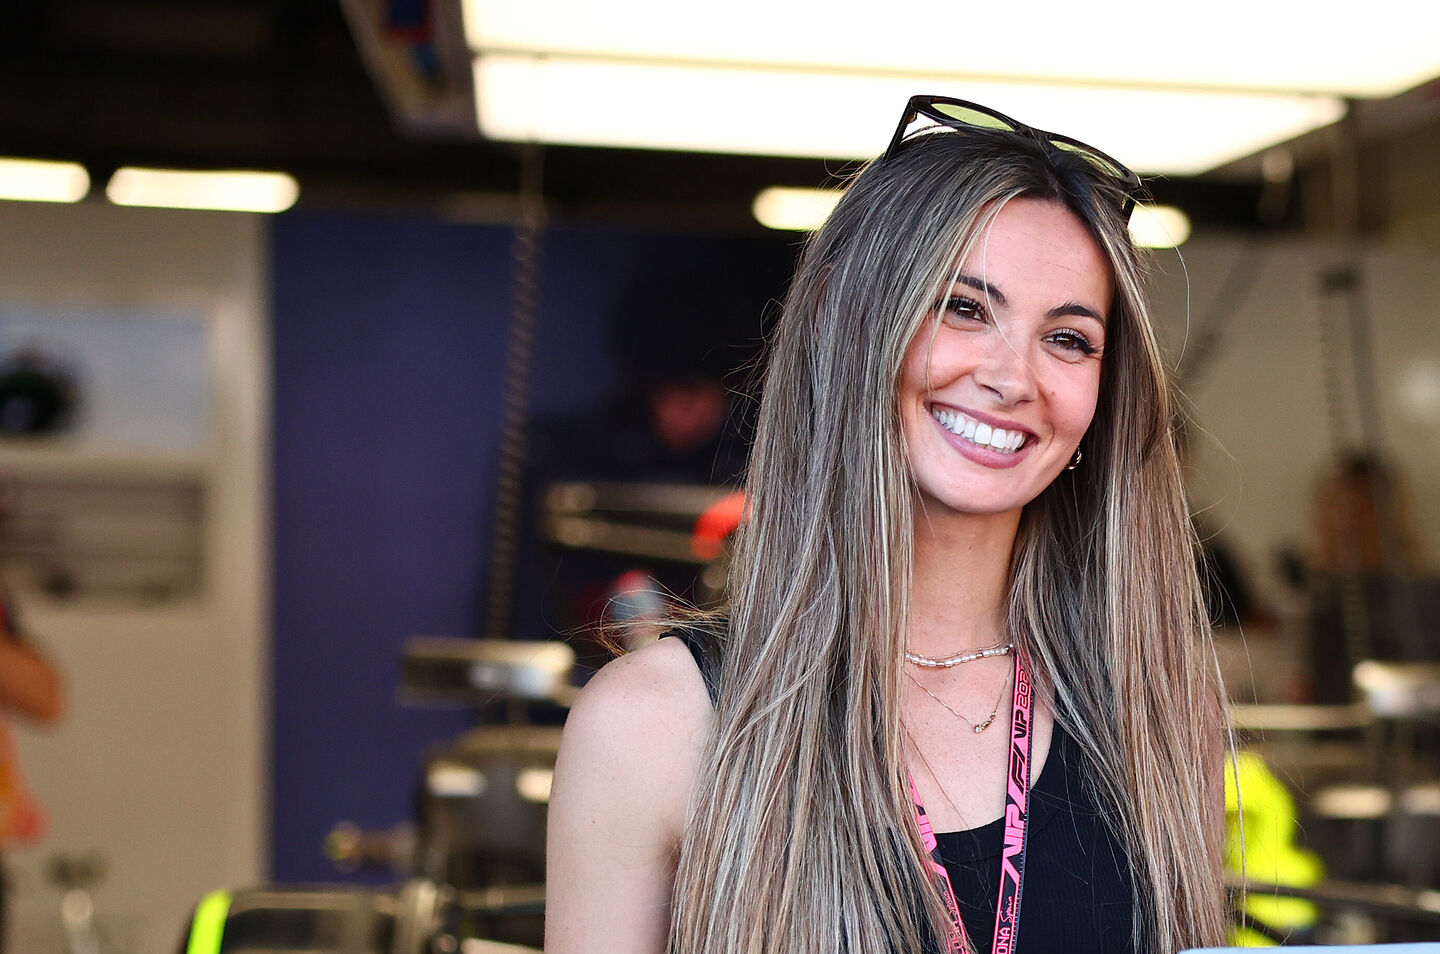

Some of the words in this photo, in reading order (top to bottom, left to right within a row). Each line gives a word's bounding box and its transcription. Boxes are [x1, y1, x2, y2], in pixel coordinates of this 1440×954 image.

[1015, 657, 1032, 709] 202
[1014, 709, 1028, 739] VIP
[1002, 803, 1025, 858] VIP
[1000, 895, 1013, 923] Spain
